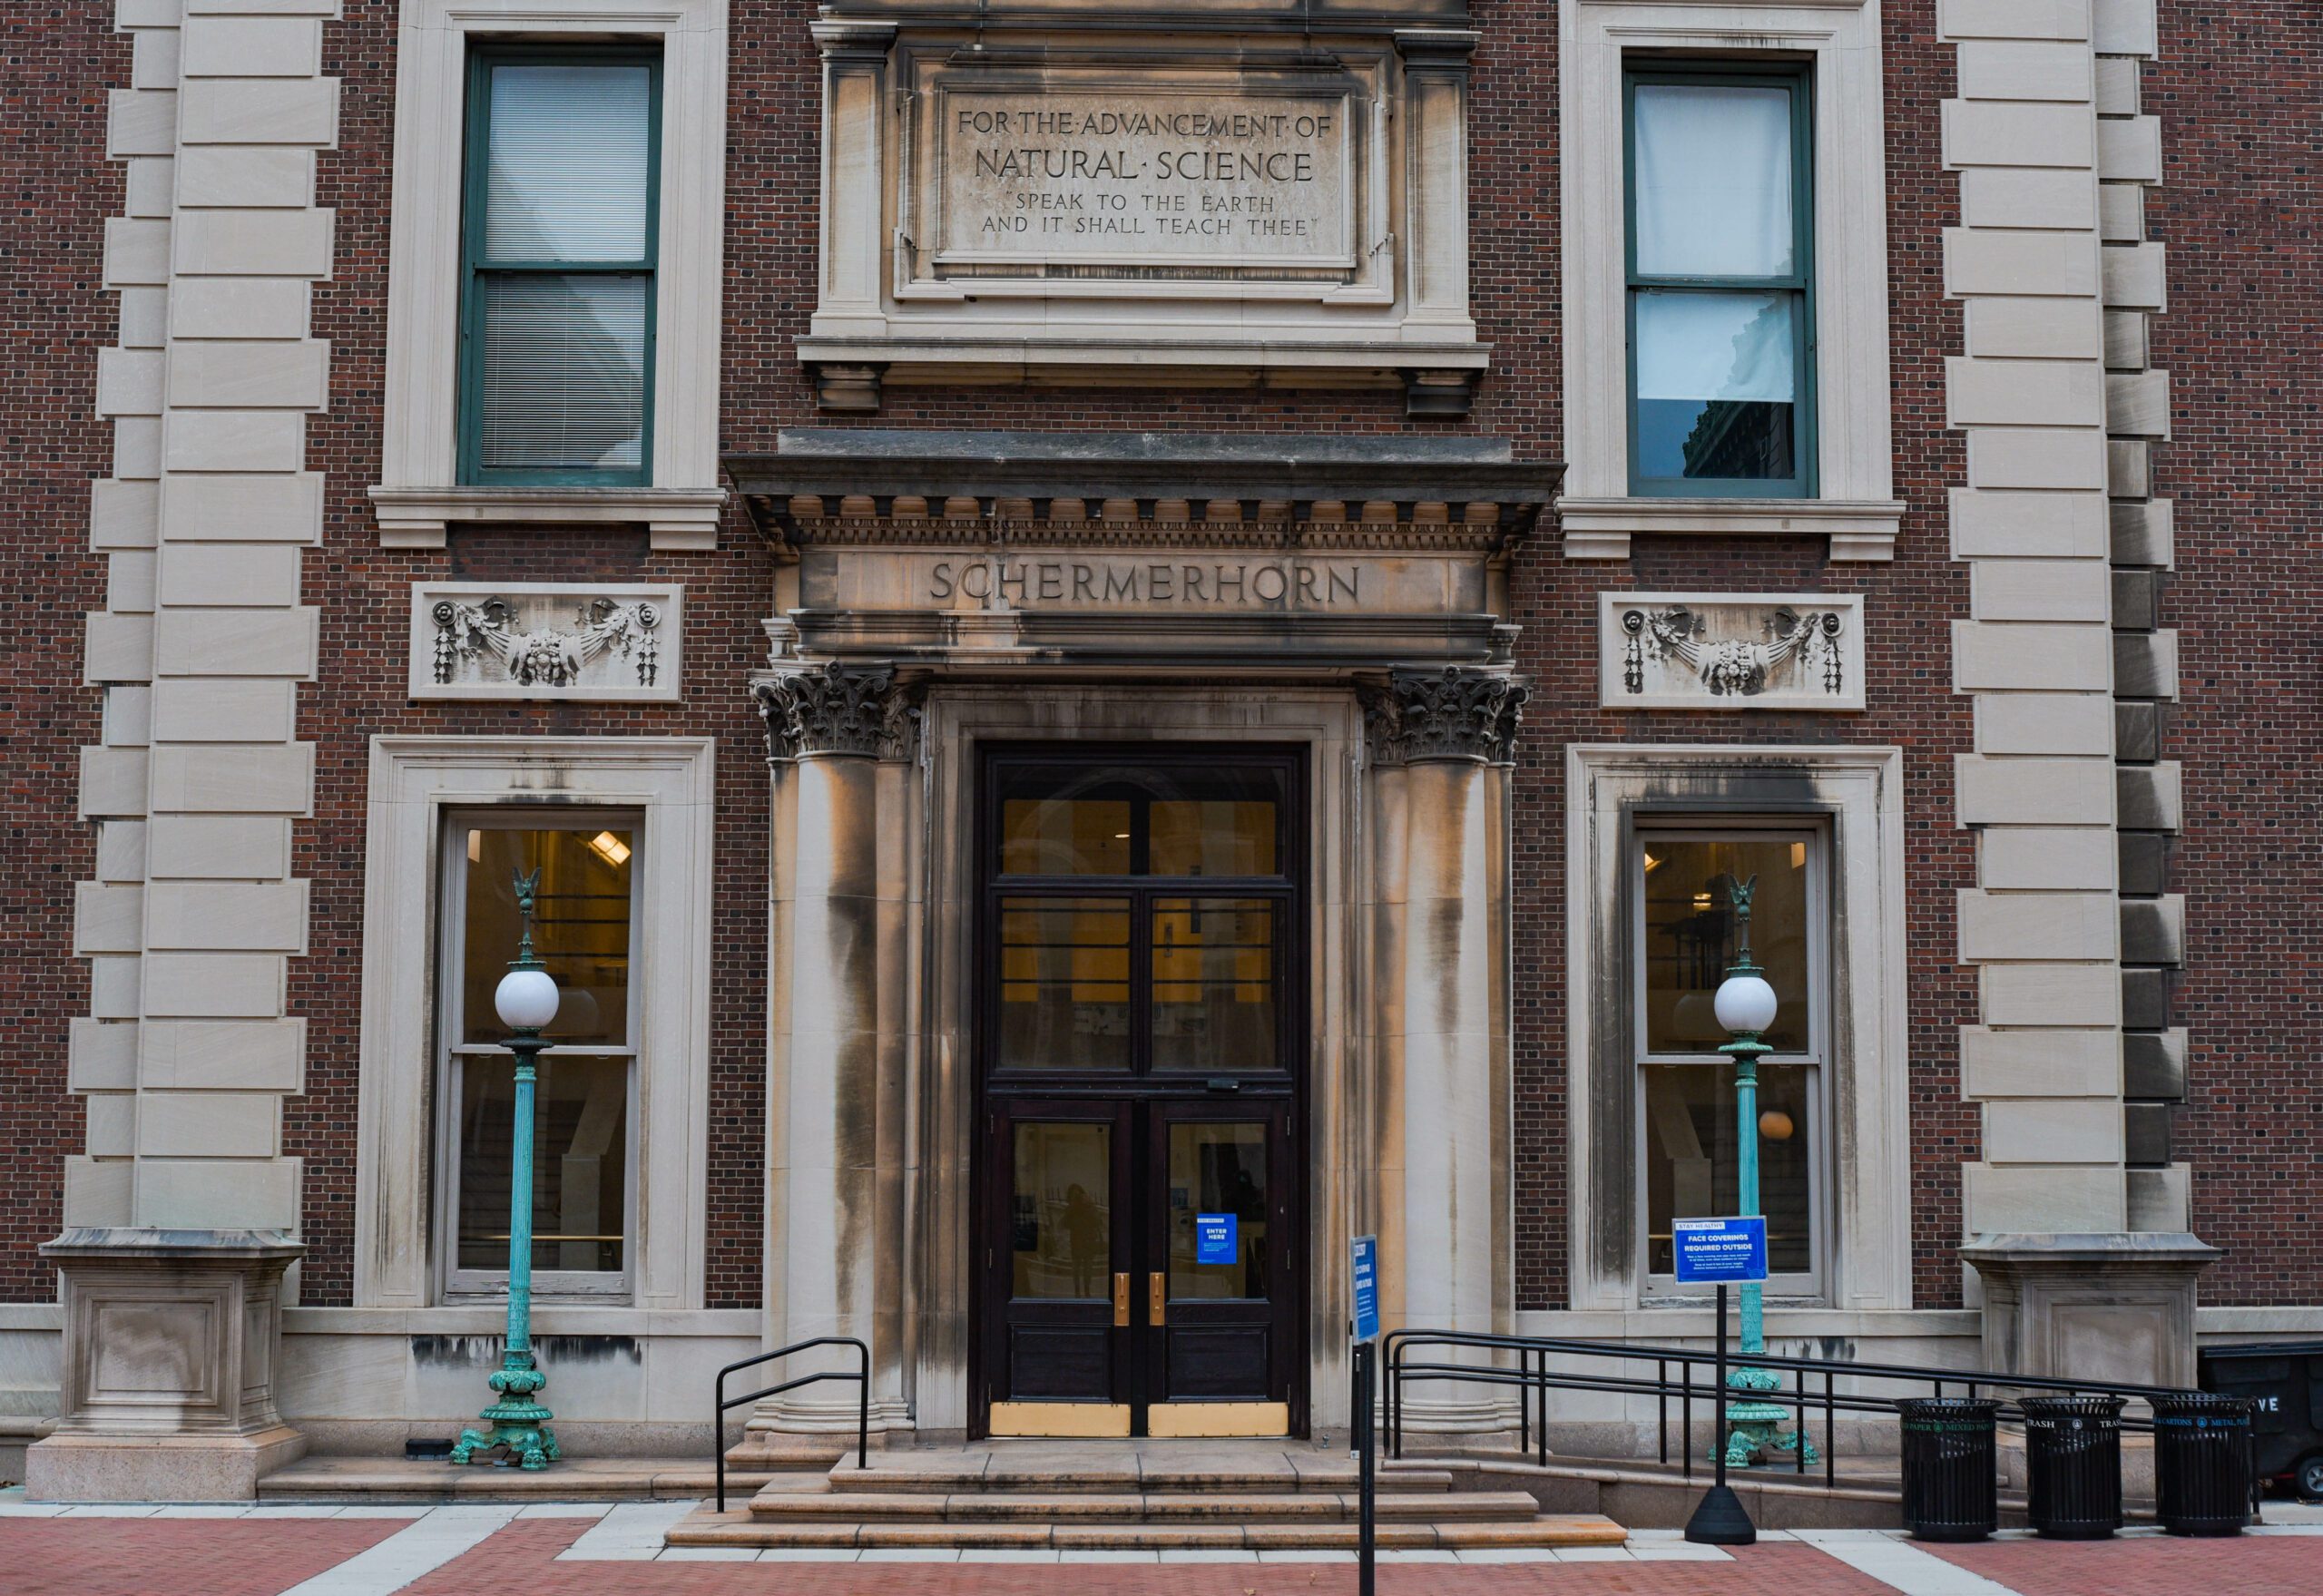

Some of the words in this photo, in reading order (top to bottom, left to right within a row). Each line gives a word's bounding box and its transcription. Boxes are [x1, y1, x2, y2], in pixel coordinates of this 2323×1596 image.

[958, 111, 1011, 133] FOR
[1017, 112, 1073, 134] THE
[1081, 113, 1287, 137] ADVANCEMENT
[1295, 116, 1331, 138] OF
[975, 149, 1139, 179] NATURAL
[1156, 152, 1313, 181] SCIENCE
[1096, 194, 1127, 211] TO
[1141, 195, 1185, 211] THE
[1201, 196, 1274, 212] EARTH
[981, 216, 1028, 232] AND
[1043, 217, 1063, 232] IT
[1075, 217, 1145, 234] SHALL
[1156, 218, 1230, 234] TEACH
[930, 563, 1360, 603] SCHERMERHORN
[1684, 1244, 1721, 1252] REQUIRED
[1721, 1243, 1752, 1251] OUTSIDE
